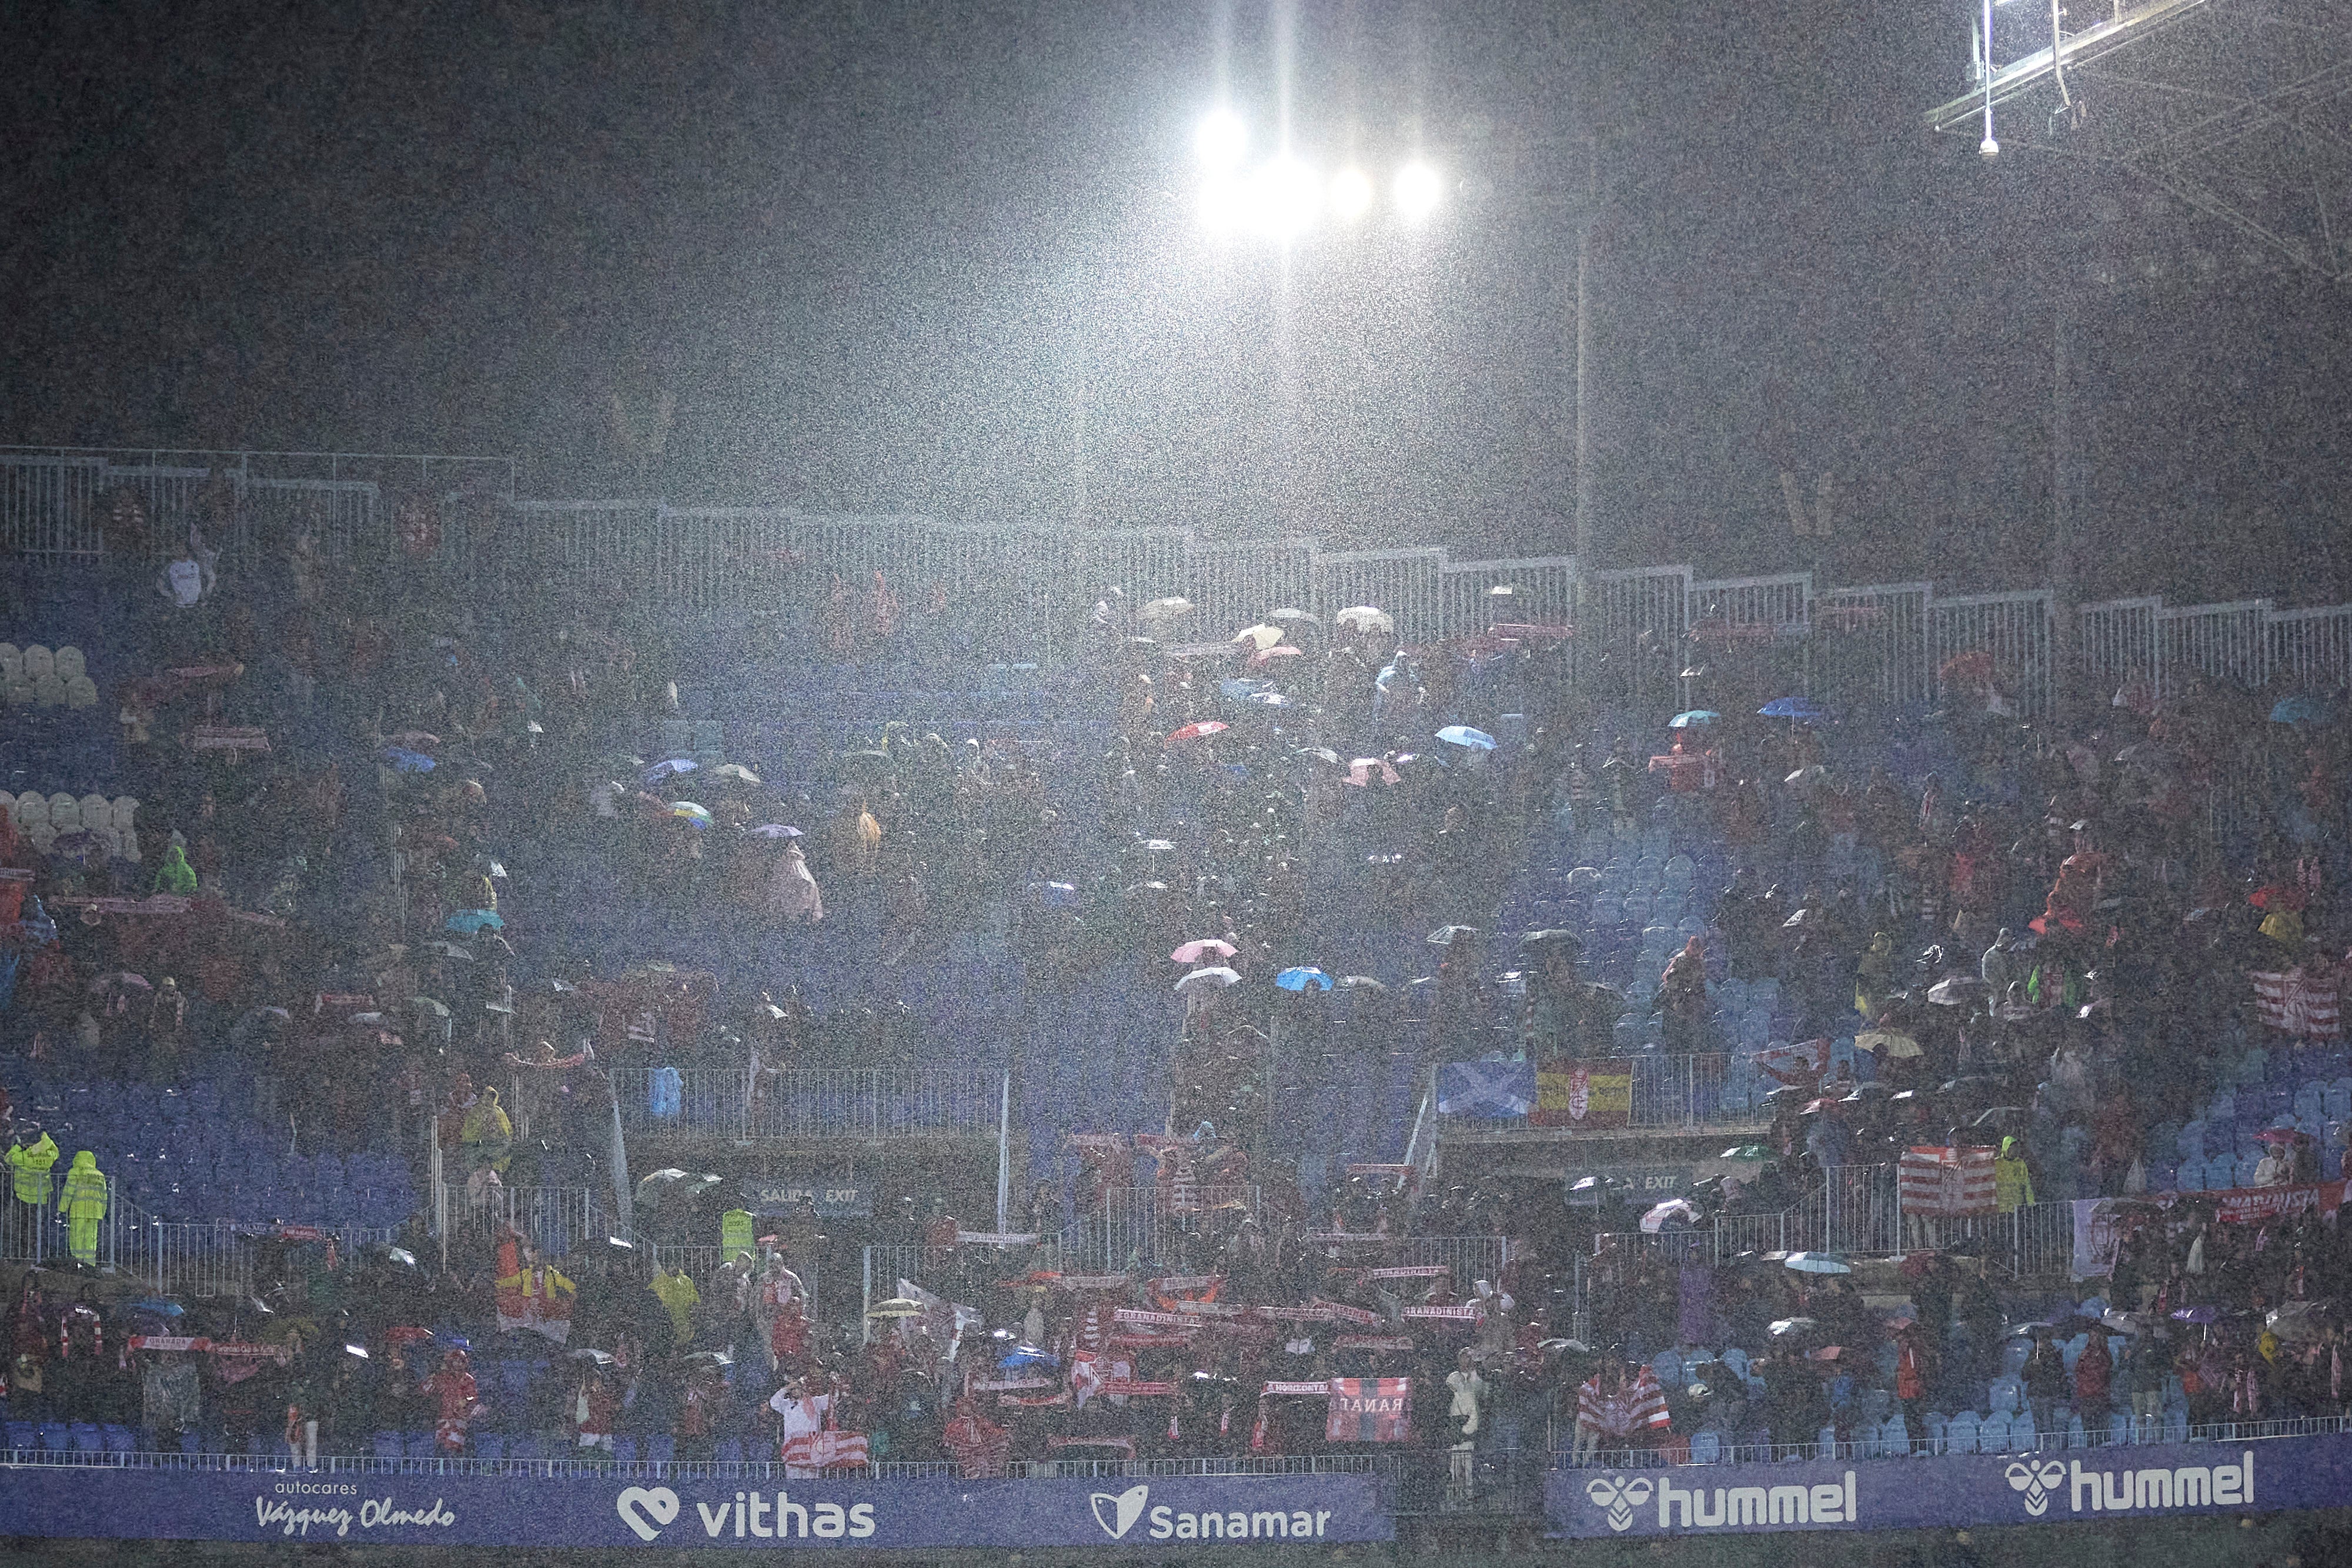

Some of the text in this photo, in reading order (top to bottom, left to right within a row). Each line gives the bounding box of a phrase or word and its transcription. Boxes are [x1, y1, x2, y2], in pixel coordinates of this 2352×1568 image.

[1646, 1176, 1677, 1189] EXIT
[826, 1189, 858, 1202] EXIT
[1123, 1312, 1196, 1325] GRANADINISTA
[1404, 1306, 1475, 1316] GRANADINISTA
[275, 1482, 357, 1495] autocares
[2070, 1452, 2254, 1512] hummel
[1659, 1470, 1856, 1527] hummel
[256, 1497, 455, 1536] Vázquez Olmedo
[697, 1492, 876, 1537] vithas
[1149, 1505, 1331, 1539] Sanamar
